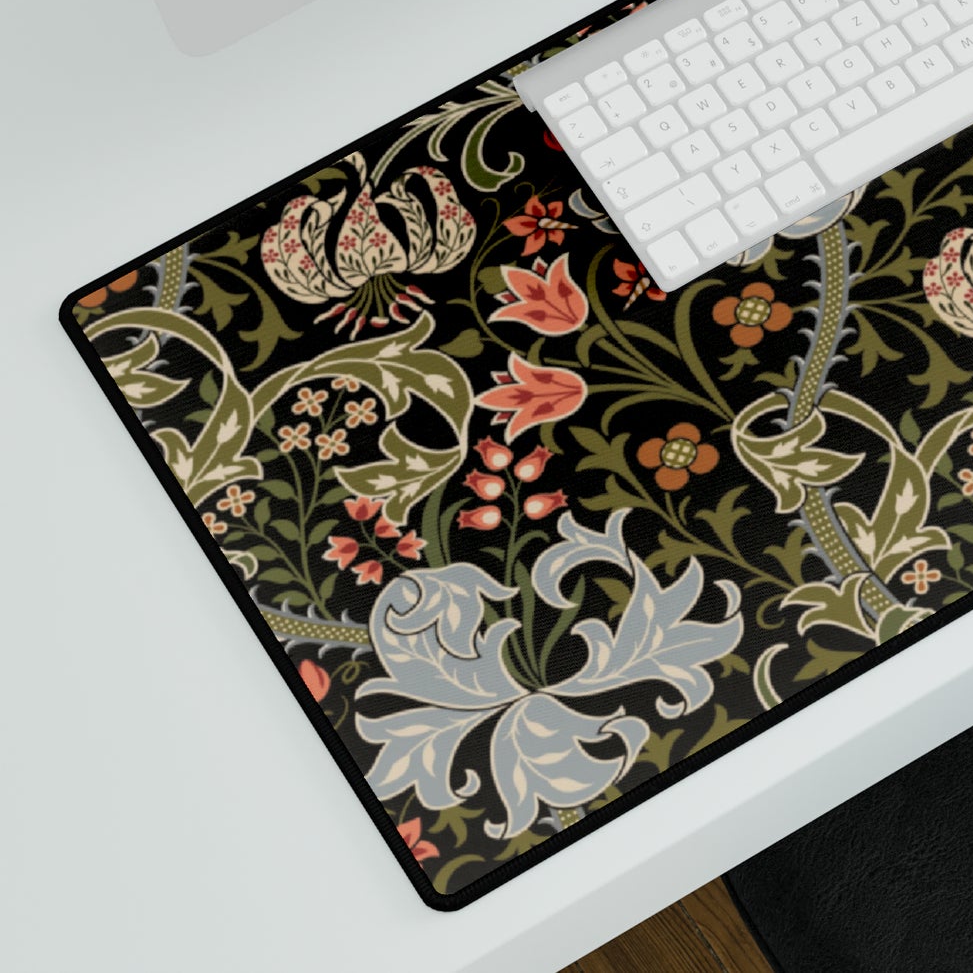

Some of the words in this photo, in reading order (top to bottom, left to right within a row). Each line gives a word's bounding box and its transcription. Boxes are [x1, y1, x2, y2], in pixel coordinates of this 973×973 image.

[759, 15, 768, 26] 5
[851, 15, 863, 27] Z
[921, 17, 929, 28] J
[721, 36, 731, 46] 4
[813, 36, 824, 47] T
[880, 37, 893, 49] H
[681, 57, 692, 68] 3
[775, 58, 786, 68] R
[842, 58, 854, 69] G
[922, 58, 935, 70] N
[643, 78, 653, 89] 2
[737, 78, 747, 90] E
[804, 79, 813, 90] F
[884, 79, 896, 90] B
[695, 98, 710, 111] W
[765, 100, 777, 112] D
[845, 99, 857, 111] V
[659, 121, 671, 132] Q
[727, 122, 738, 133] S
[808, 121, 820, 132] C
[689, 143, 700, 155] A
[768, 142, 782, 154] X
[730, 163, 740, 174] Y
[784, 195, 801, 208] cmd
